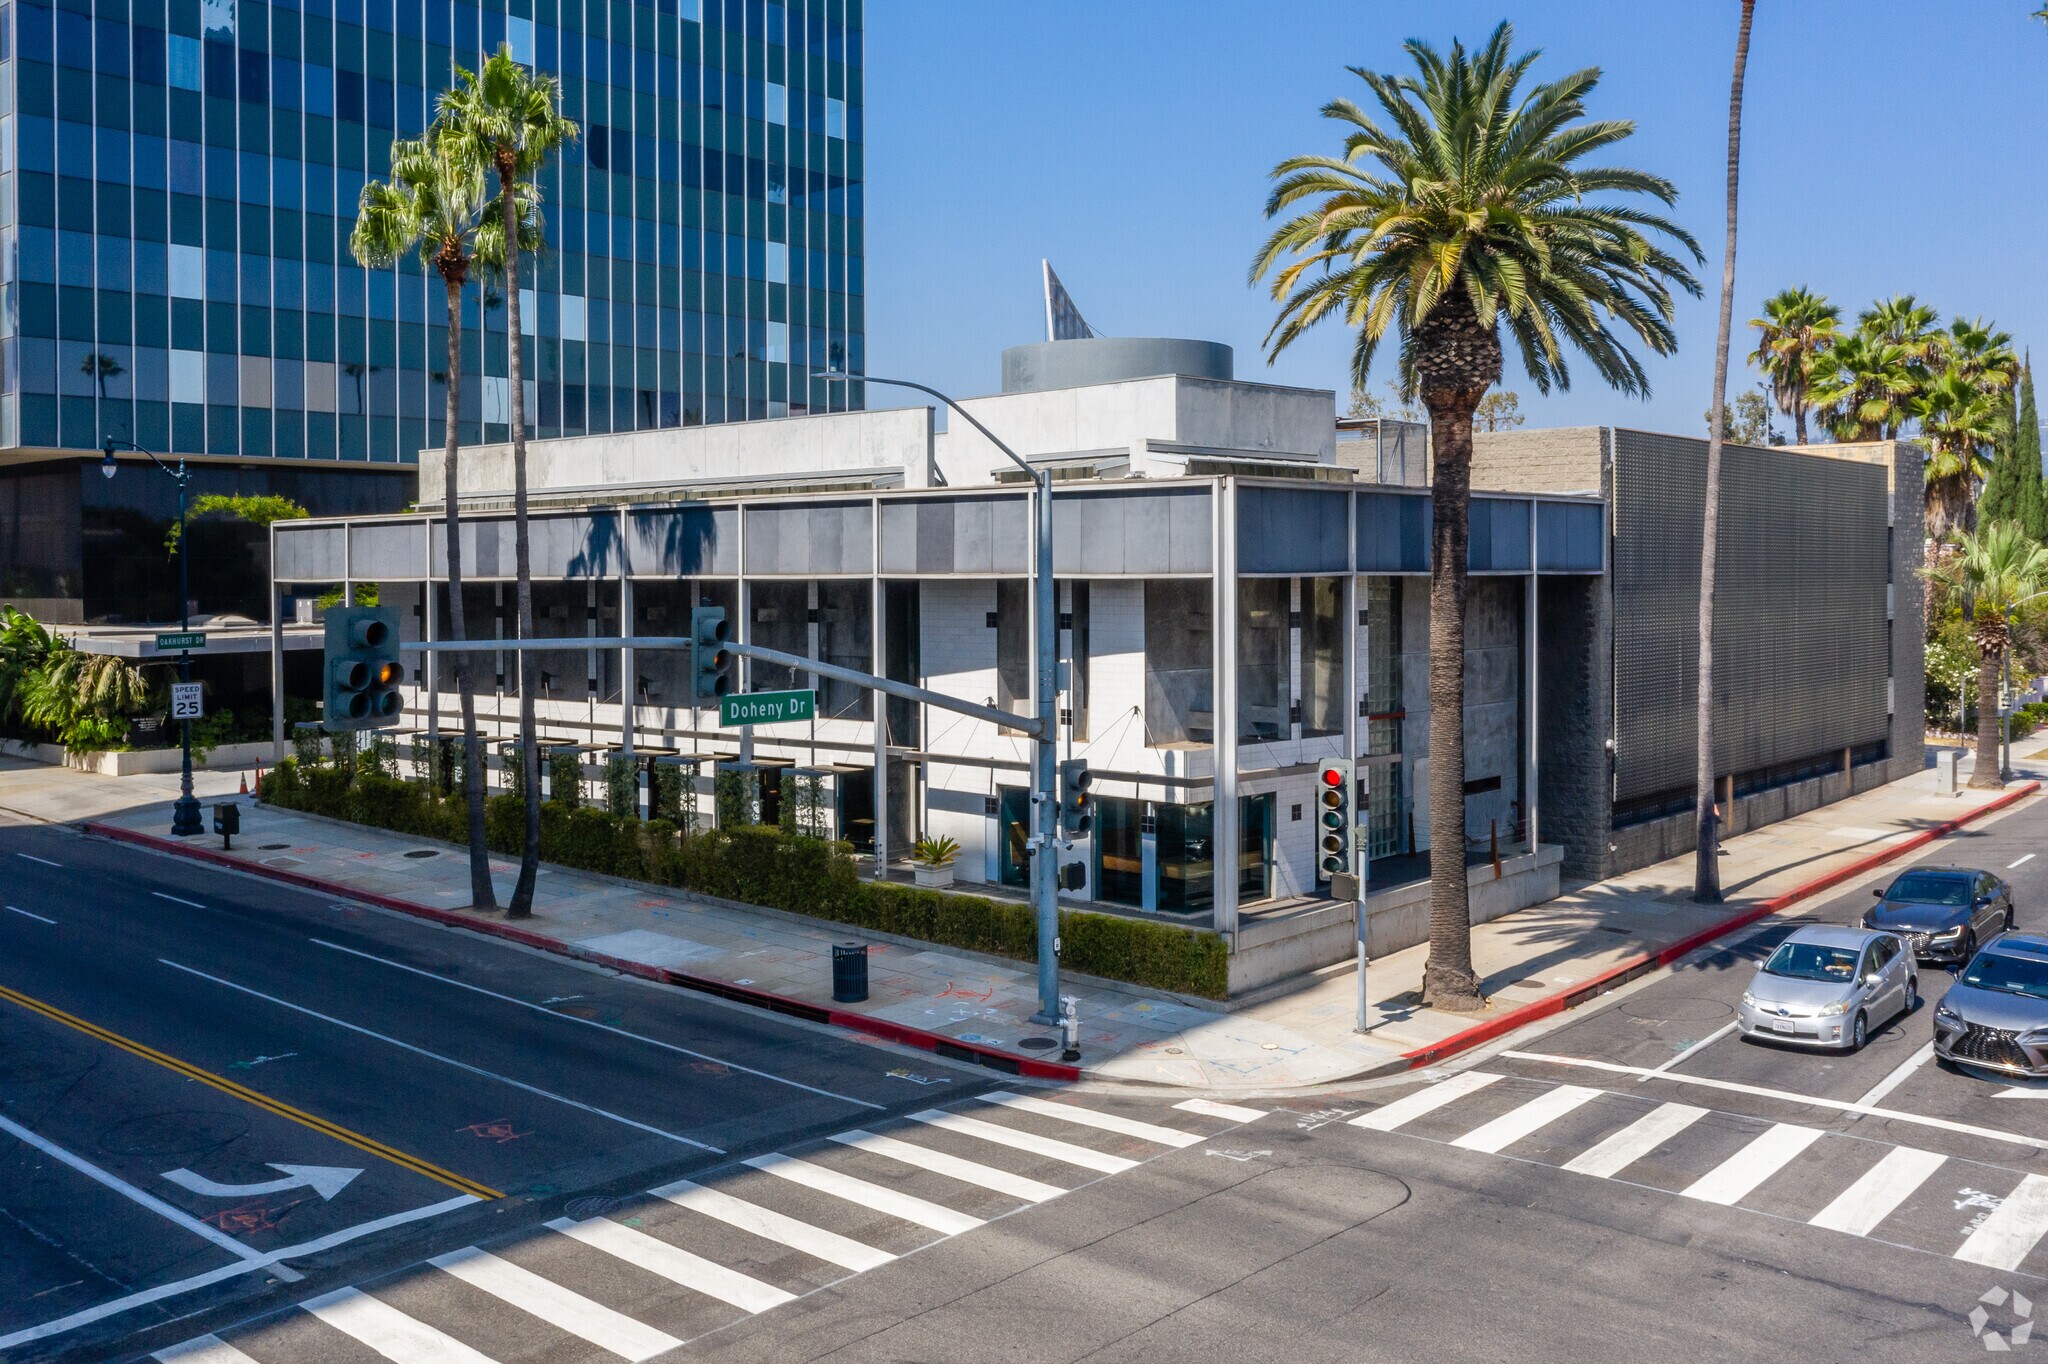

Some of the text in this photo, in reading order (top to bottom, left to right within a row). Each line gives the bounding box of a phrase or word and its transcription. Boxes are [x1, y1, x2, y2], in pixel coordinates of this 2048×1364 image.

[160, 636, 204, 646] OAKHURST DR
[176, 702, 199, 715] 25
[730, 698, 805, 720] Doheny Dr
